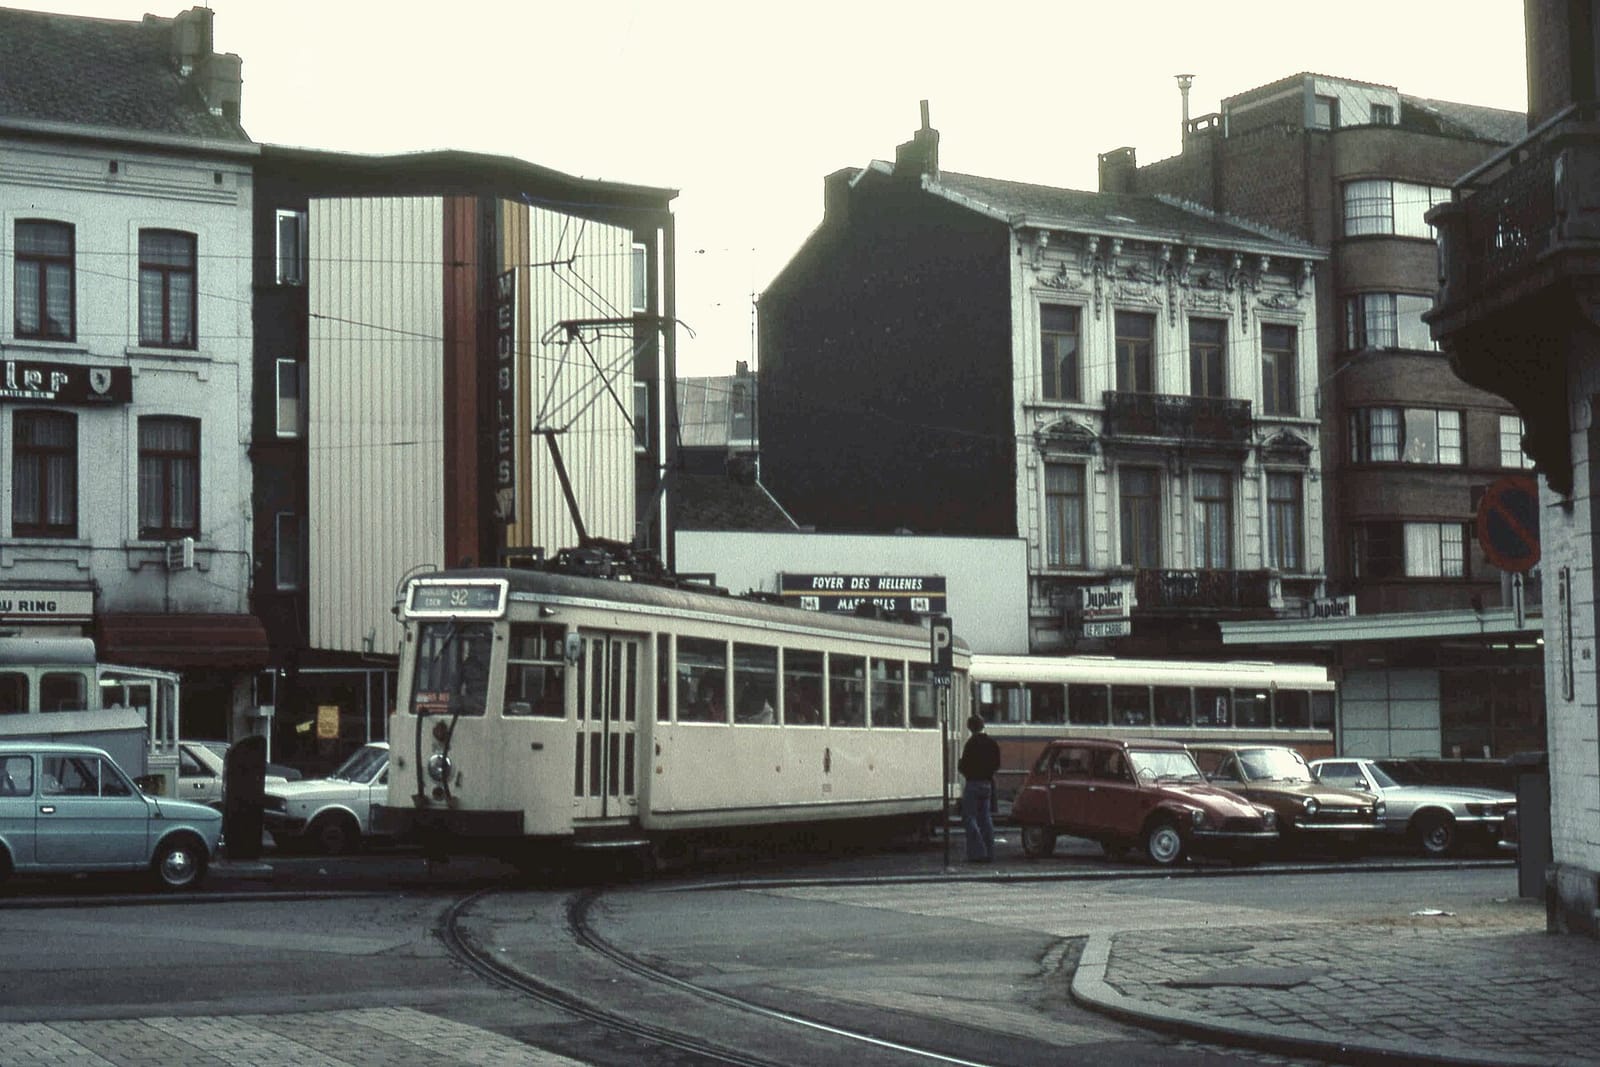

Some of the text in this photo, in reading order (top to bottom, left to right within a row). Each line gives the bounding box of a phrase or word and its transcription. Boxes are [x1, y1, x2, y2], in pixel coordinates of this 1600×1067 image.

[498, 273, 511, 483] MEUBLES
[812, 577, 923, 590] FOYER DES HELLENES
[18, 600, 57, 612] RING
[451, 588, 469, 606] 92
[1085, 586, 1123, 611] Jupiler
[933, 625, 949, 664] P
